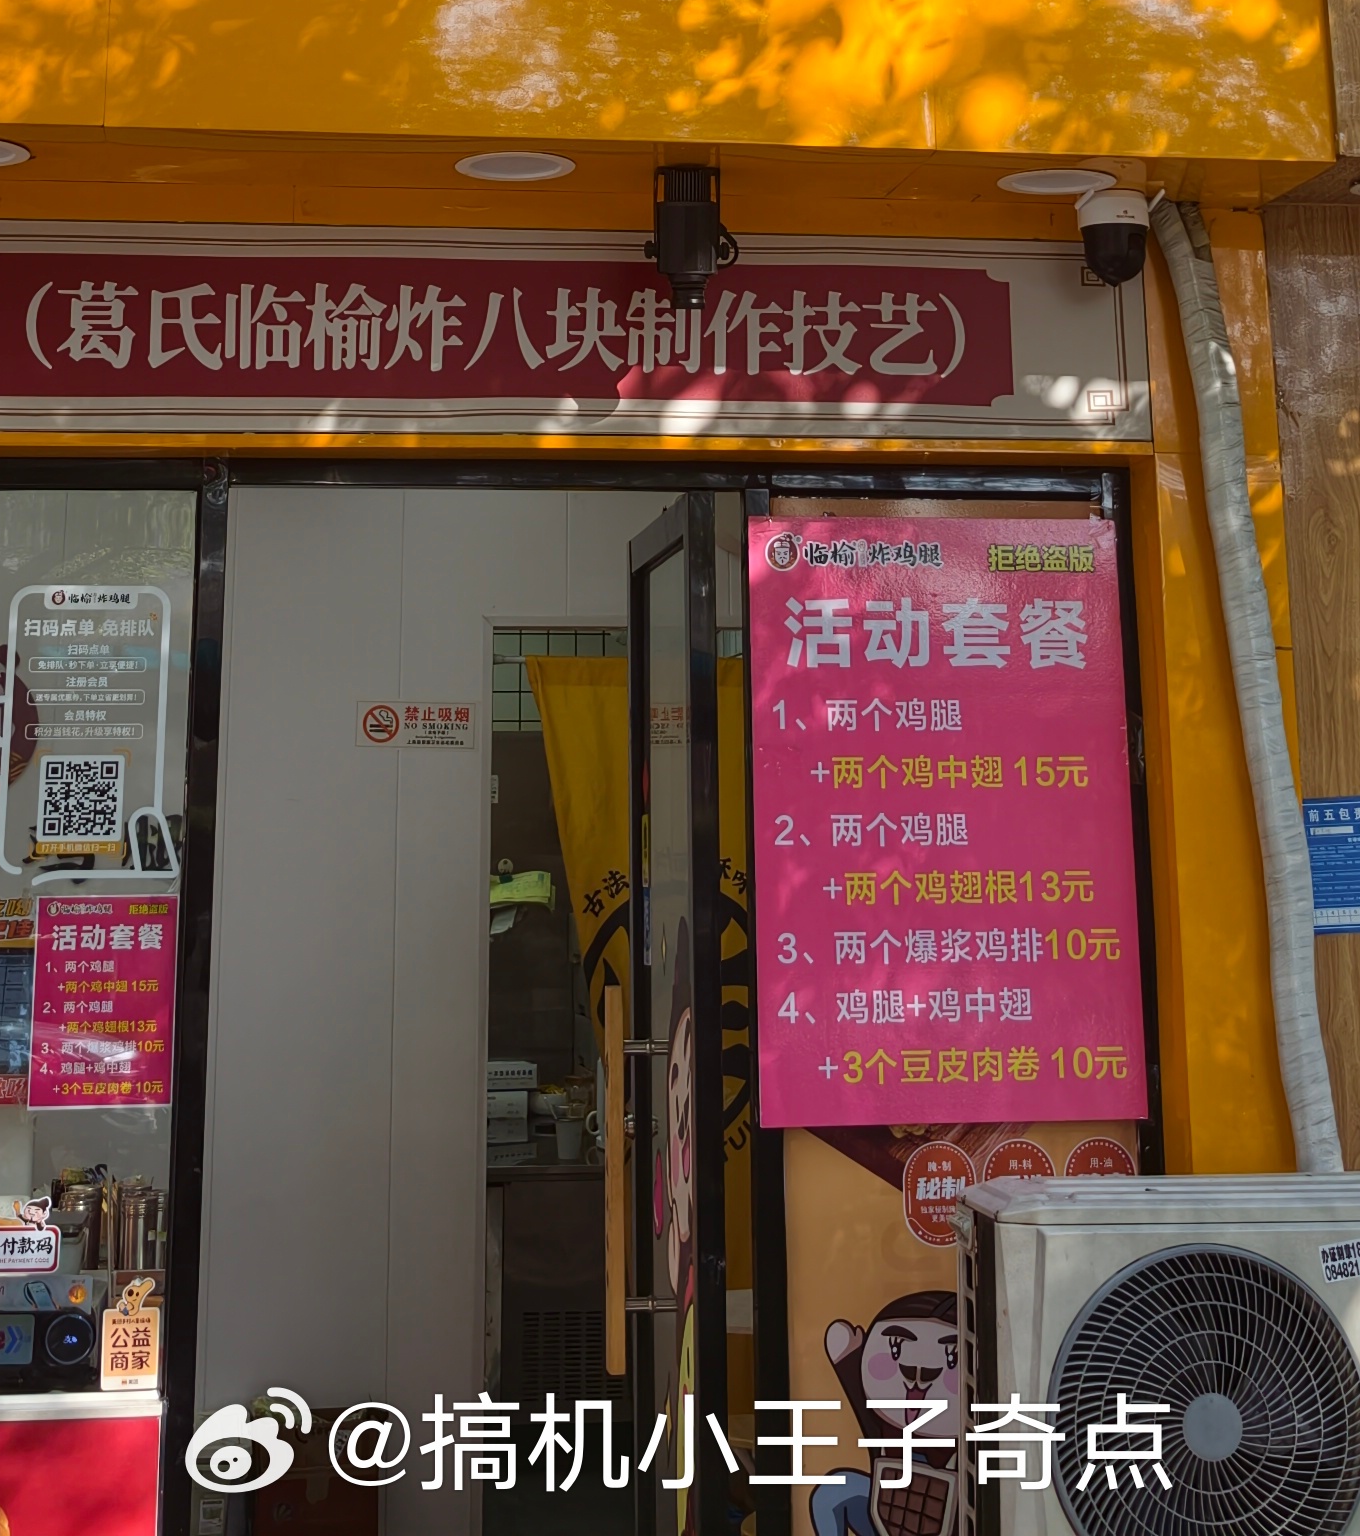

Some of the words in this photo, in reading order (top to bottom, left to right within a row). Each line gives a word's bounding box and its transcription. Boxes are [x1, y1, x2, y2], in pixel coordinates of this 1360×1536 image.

[24, 280, 968, 379] （葛氏临榆炸八块制作技艺）
[804, 541, 943, 568] 临榆炸鸡腿
[987, 544, 1095, 572] 拒绝盗版
[24, 619, 95, 637] 扫码点单
[102, 619, 154, 637] 免排队
[783, 596, 1088, 670] 活动套餐
[67, 644, 110, 656] 扫码点单
[66, 677, 108, 688] 注册会员
[64, 710, 107, 721] 会员特权
[404, 706, 470, 723] 禁止吸烟
[772, 698, 963, 732] 1、两个鸡腿
[404, 722, 417, 730] NO
[422, 722, 468, 731] SMOKING
[810, 754, 1004, 789] +两个鸡中翅
[1014, 755, 1089, 788] 15元
[774, 813, 969, 847] 2、两个鸡腿
[822, 870, 1095, 906] +两个鸡翅根13元
[128, 903, 169, 915] 拒绝盗版
[51, 923, 164, 951] 活动套餐
[777, 927, 1121, 965] 3、两个爆浆鸡排10元
[45, 960, 115, 973] 1、两个鸡腿
[58, 980, 128, 993] +两个鸡中翅
[131, 980, 159, 992] 15元
[43, 1000, 114, 1014] 2、两个鸡腿
[777, 987, 1033, 1024] 4、鸡腿+鸡中翅
[59, 1021, 158, 1034] +两个鸡翅根13元
[39, 1061, 132, 1075] 4、鸡腿+鸡中翅
[818, 1046, 1040, 1085] +3个豆皮肉卷
[1051, 1046, 1127, 1080] 10元
[52, 1082, 132, 1096] +3个豆皮肉卷
[136, 1082, 164, 1094] 10元
[915, 1175, 966, 1201] 秘制
[110, 1327, 151, 1348] 公益
[110, 1350, 151, 1371] 商家
